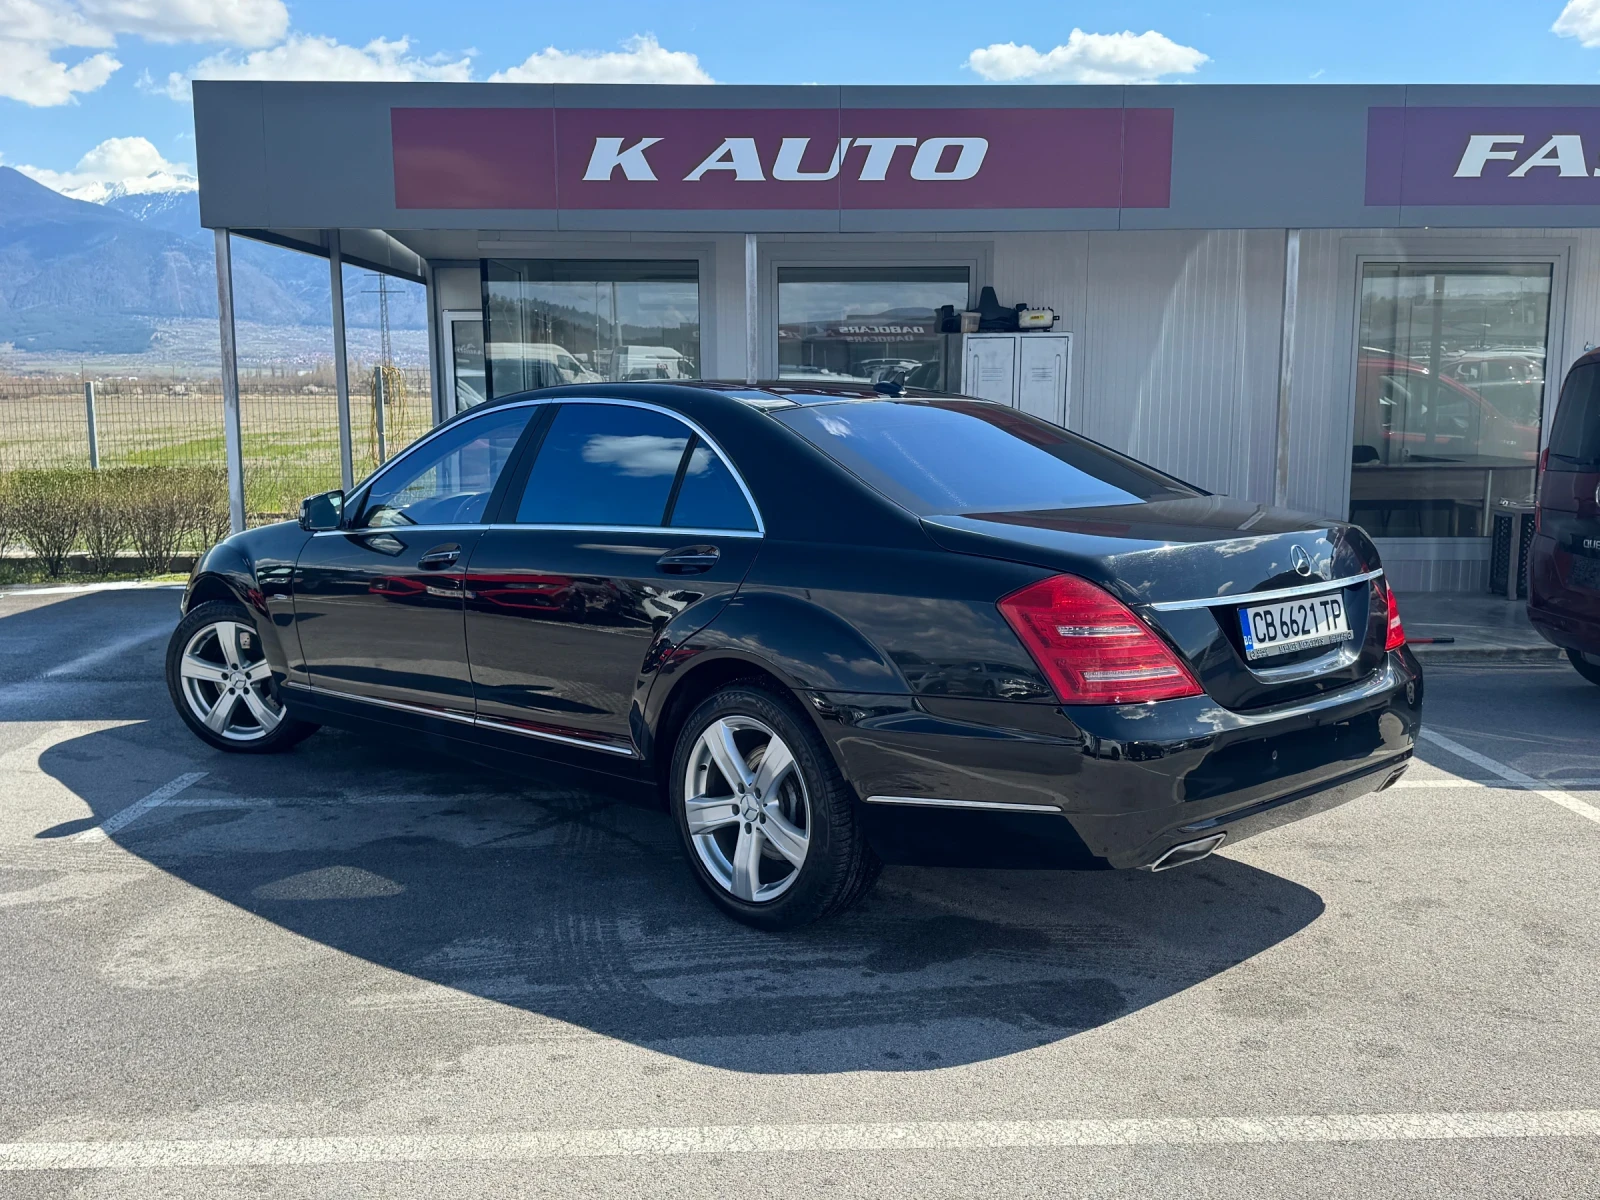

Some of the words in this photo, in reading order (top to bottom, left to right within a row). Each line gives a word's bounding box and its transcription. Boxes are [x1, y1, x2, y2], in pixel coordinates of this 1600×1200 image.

[583, 137, 665, 181] K
[683, 137, 989, 182] AUTO
[1453, 134, 1600, 178] FA
[1243, 635, 1253, 645] BG
[1252, 611, 1277, 643] CB
[1280, 602, 1319, 638] 6621
[1320, 599, 1341, 631] TP
[796, 739, 827, 819] ROADX
